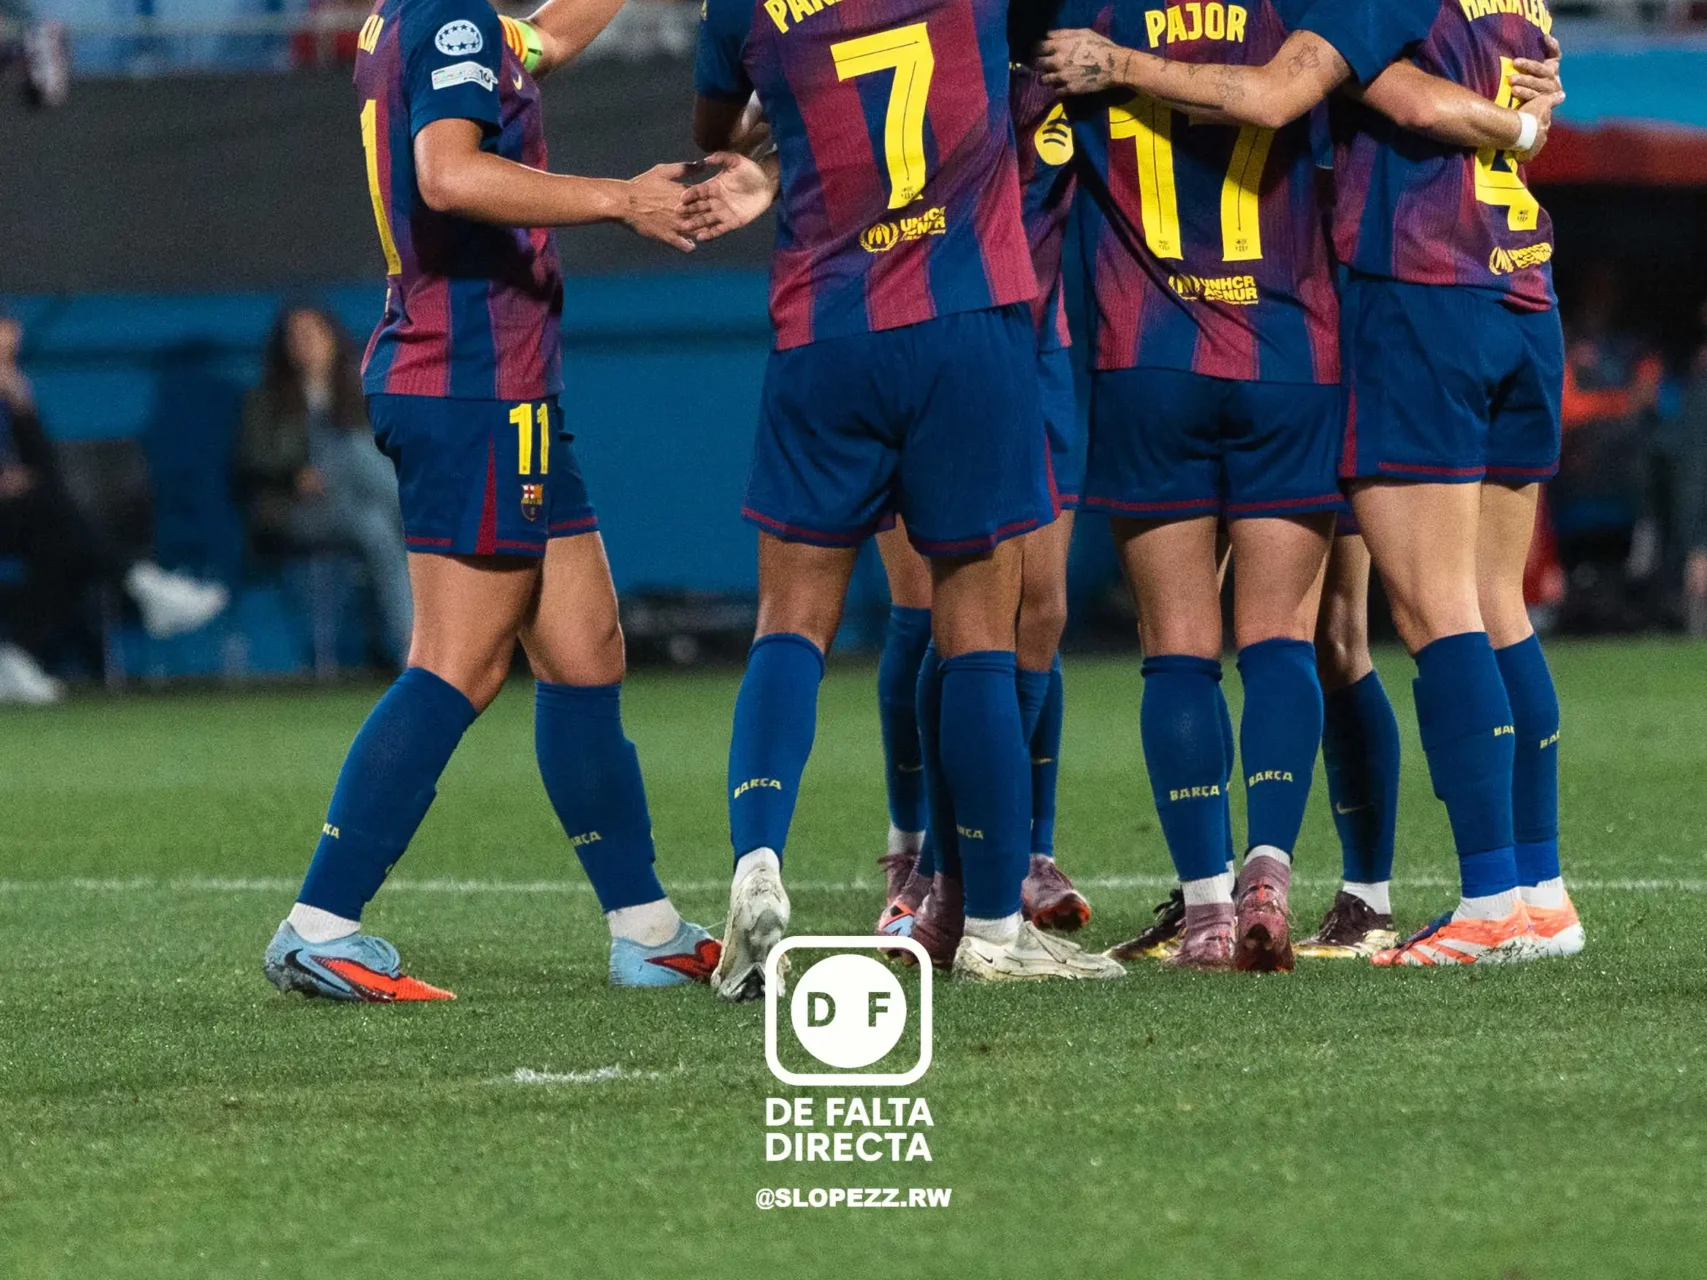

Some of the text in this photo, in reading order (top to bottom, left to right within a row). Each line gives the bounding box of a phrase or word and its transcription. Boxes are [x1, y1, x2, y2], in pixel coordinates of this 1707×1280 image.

[1145, 2, 1248, 48] PAJOR
[830, 22, 935, 210] 7
[1108, 94, 1276, 262] 17
[509, 403, 549, 475] 11
